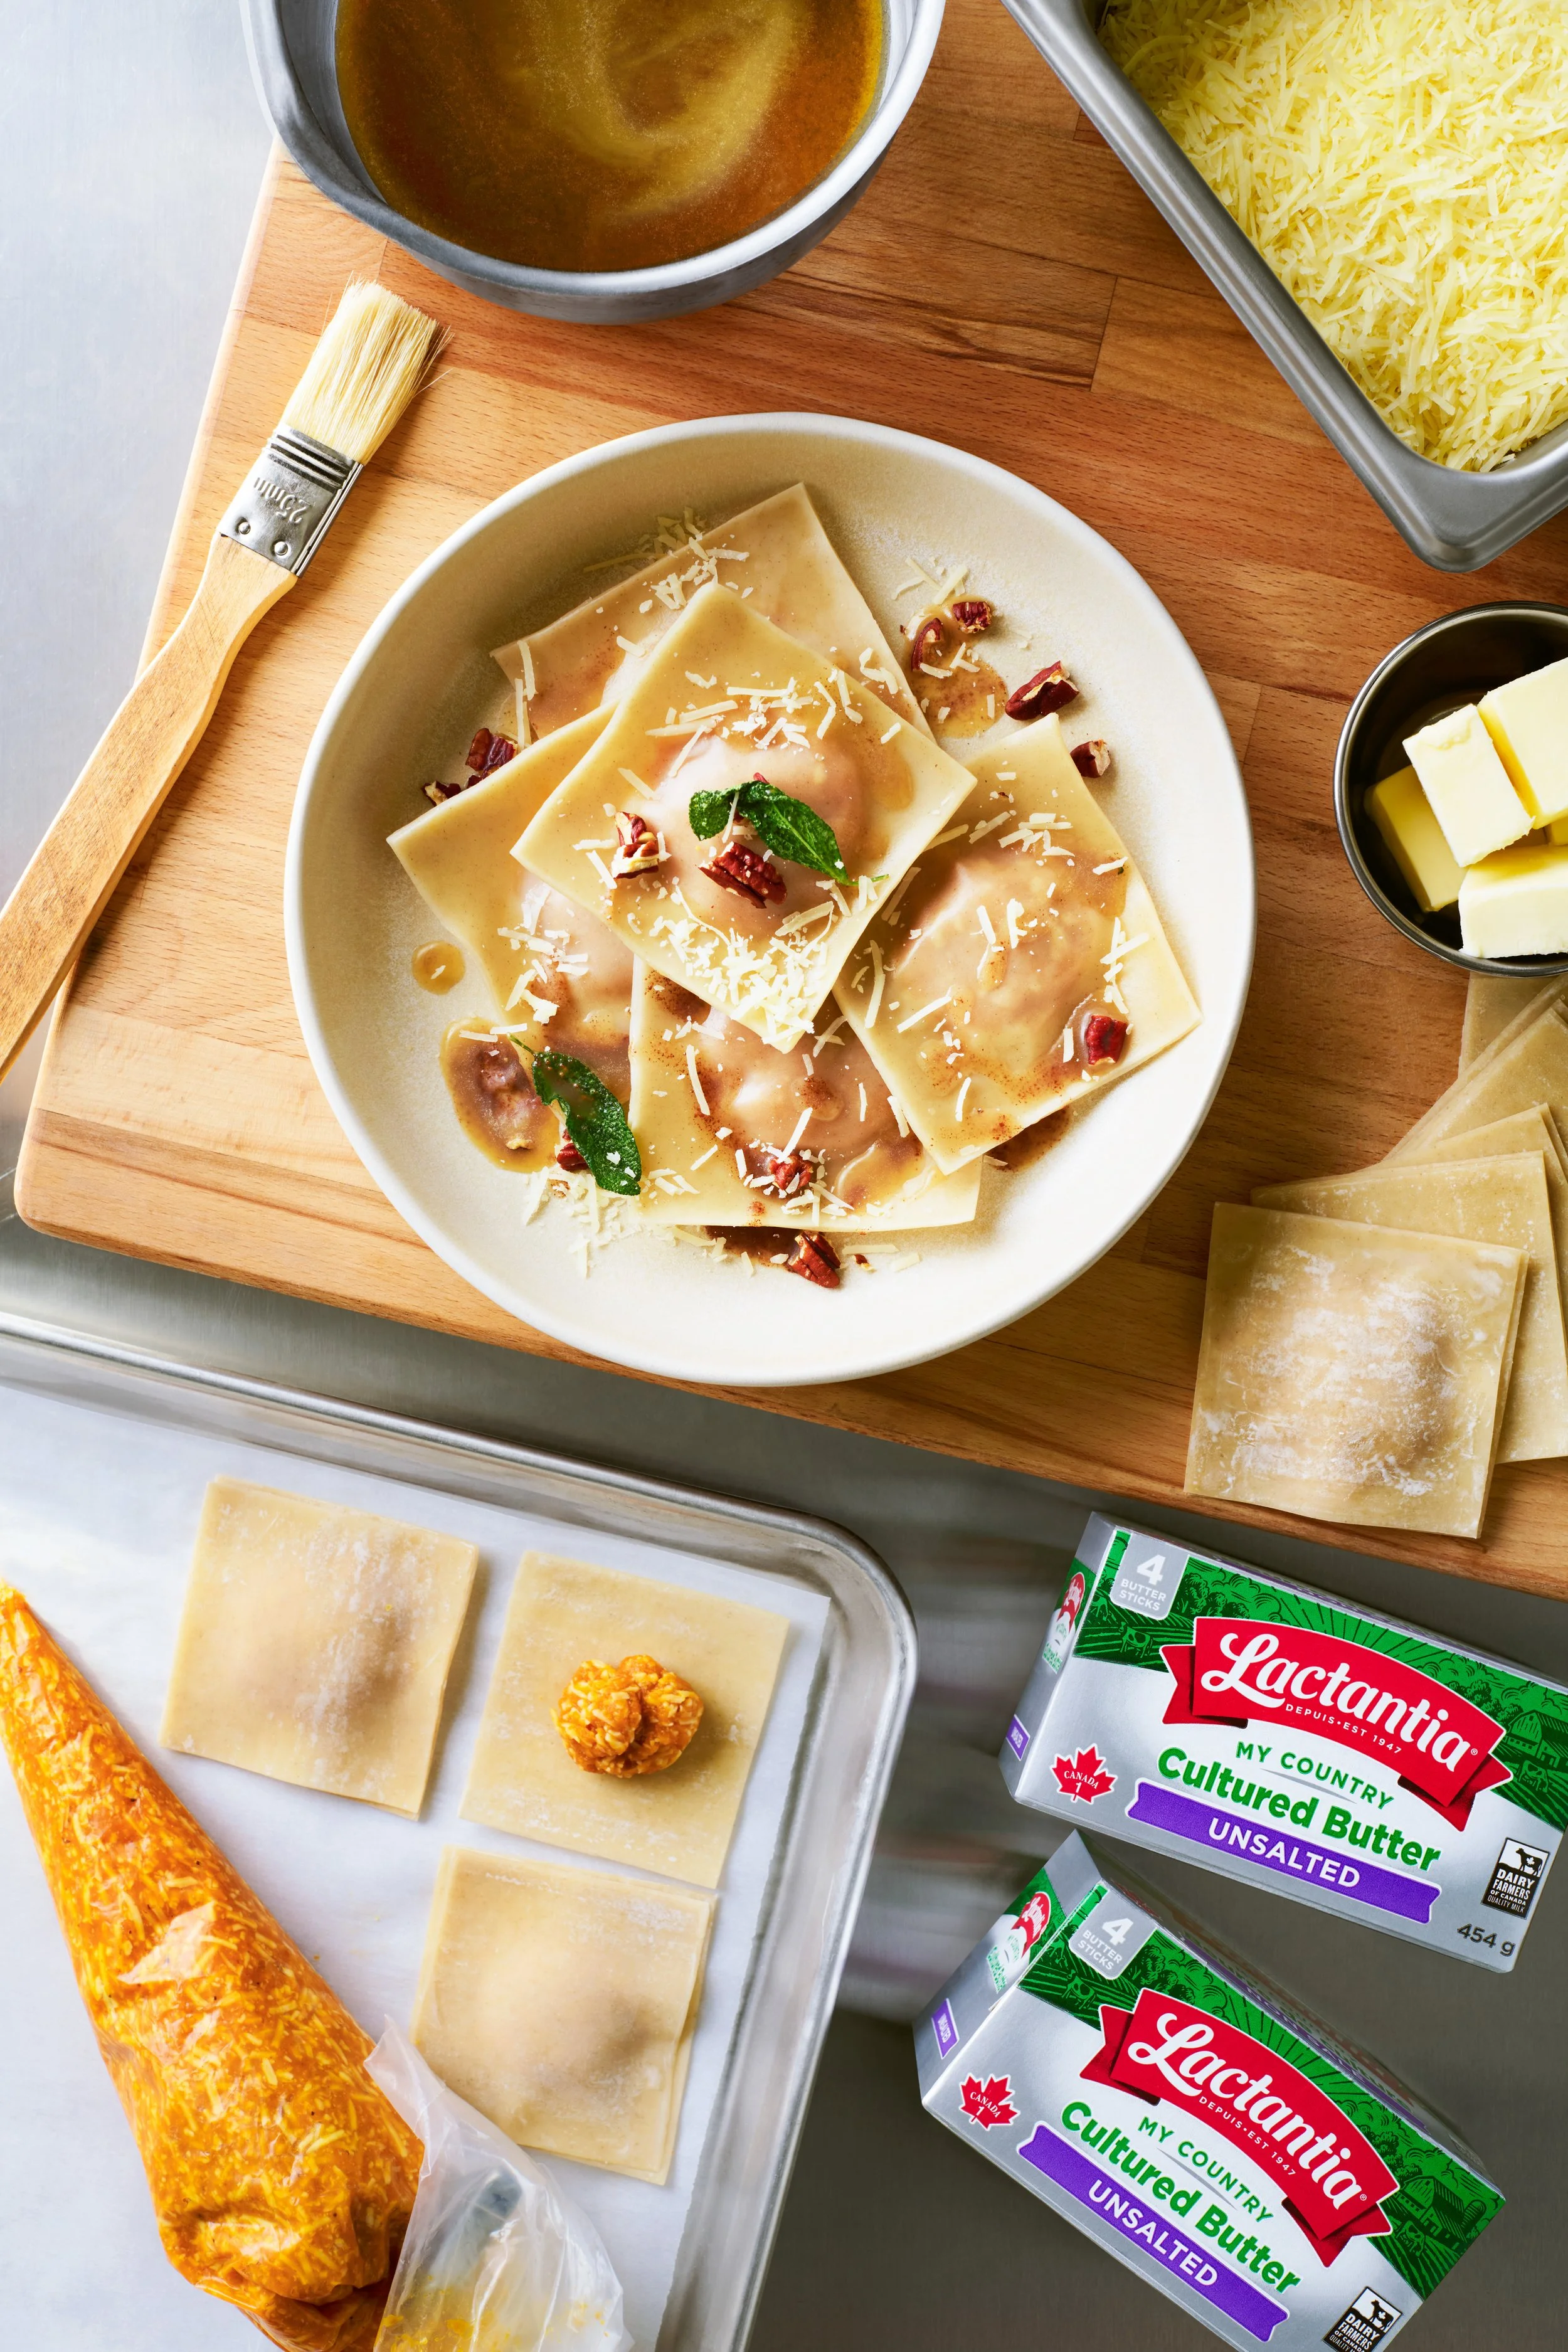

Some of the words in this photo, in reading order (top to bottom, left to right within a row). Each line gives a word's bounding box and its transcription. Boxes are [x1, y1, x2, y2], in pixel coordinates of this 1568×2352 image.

[1136, 1554, 1166, 1586] 4
[1119, 1589, 1160, 1611] STICKS
[1121, 1578, 1166, 1602] BUTTER
[1372, 1735, 1402, 1754] 1947
[1064, 1771, 1099, 1789] CANADA
[1076, 1782, 1082, 1793] 1
[1235, 1740, 1272, 1763] MY
[1280, 1751, 1394, 1810] COUNTRY
[1157, 1747, 1311, 1830] Cultured
[1321, 1805, 1441, 1872] Butter
[1209, 1816, 1360, 1888] UNSALTED
[1492, 1879, 1530, 1900] FARMERS
[1496, 1868, 1535, 1888] DAIRY
[1487, 1895, 1510, 1908] QUALITY
[1511, 1902, 1525, 1913] MILK
[1500, 1893, 1526, 1906] CANADA
[1102, 1918, 1133, 1946] 4
[1457, 1923, 1498, 1949] 454
[1500, 1941, 1516, 1957] g
[1078, 1940, 1114, 1970] STICKS
[1083, 1930, 1122, 1964] BUTTER
[970, 2092, 1001, 2118] CANADA
[976, 2106, 985, 2116] 1
[1138, 2117, 1173, 2143] MY
[1177, 2141, 1274, 2222] COUNTRY
[1271, 2151, 1296, 2176] 1947
[1060, 2101, 1202, 2217] Cultured
[1194, 2204, 1301, 2293] Butter
[1088, 2180, 1217, 2288] UNSALTED
[1338, 2321, 1372, 2350] FARMERS
[1345, 2312, 1380, 2341] DAIRY
[1329, 2334, 1350, 2352] QUALITY
[1343, 2336, 1364, 2352] CANAD
